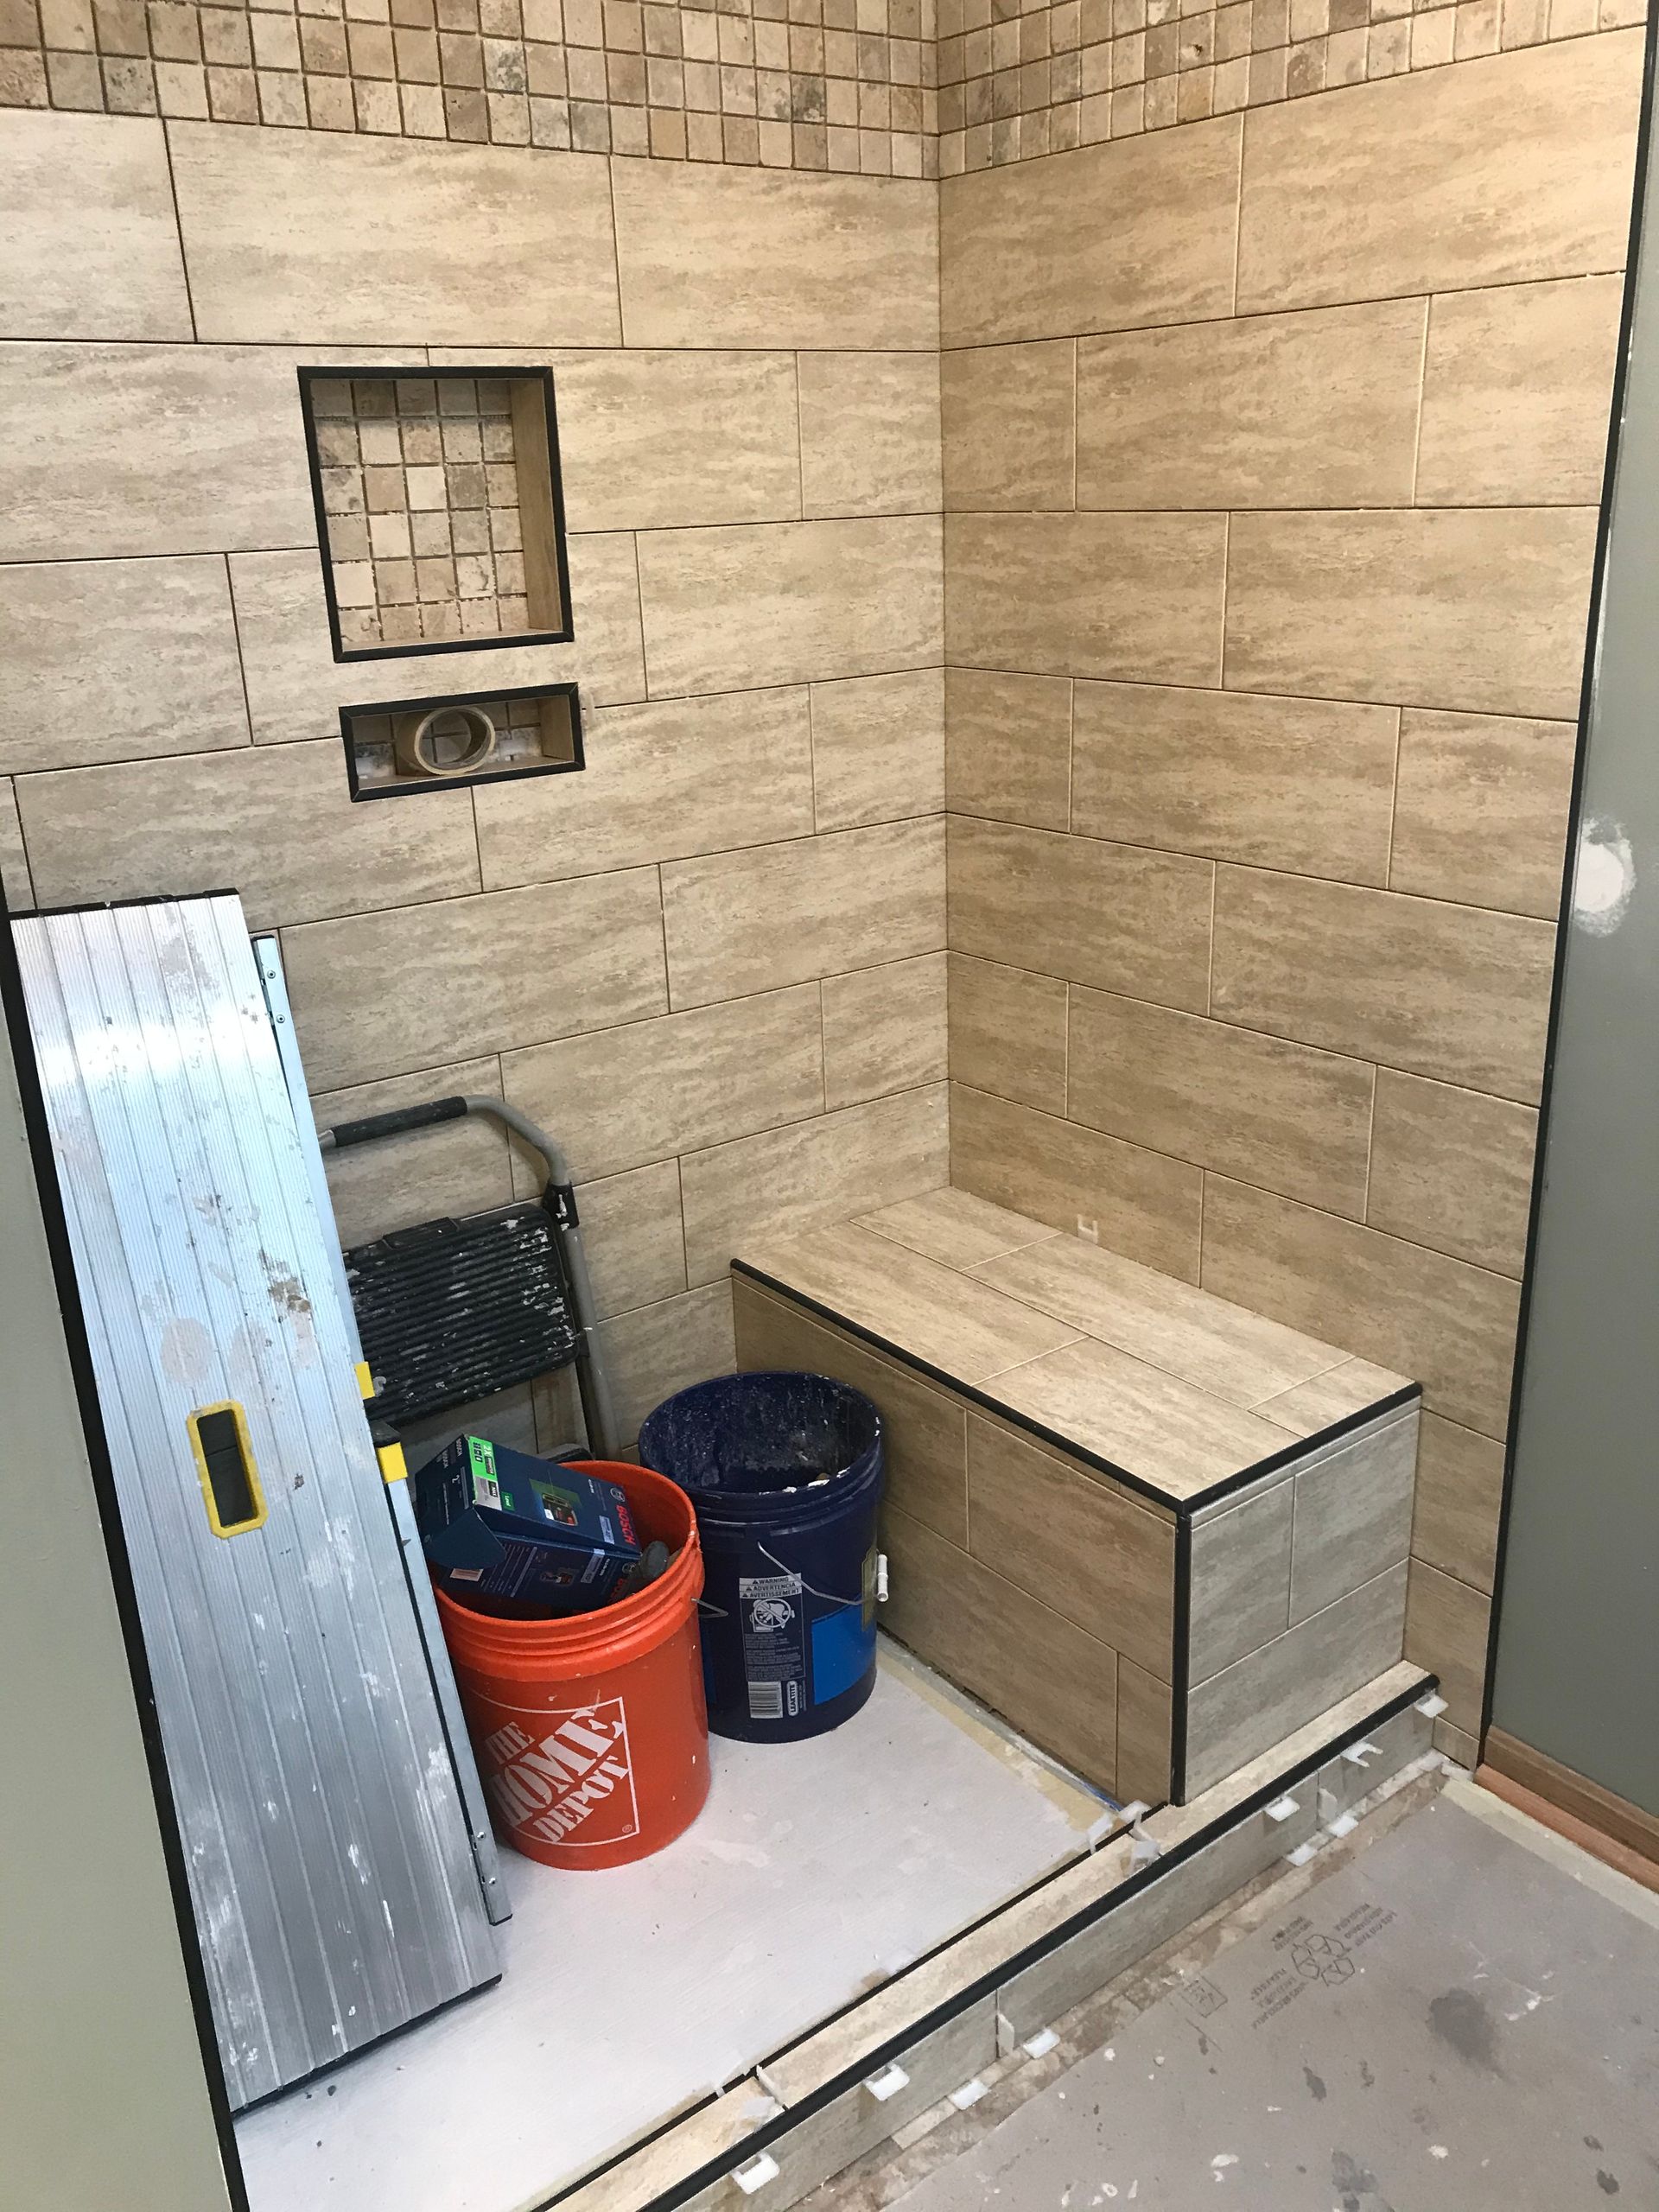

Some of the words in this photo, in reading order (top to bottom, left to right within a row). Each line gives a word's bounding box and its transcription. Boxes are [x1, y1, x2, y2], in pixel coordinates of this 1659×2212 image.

[615, 1504, 637, 1546] BOSCH
[749, 1588, 799, 1598] AVERTISSEMENT
[753, 1582, 796, 1591] ADVERTENCIA
[485, 1721, 536, 1765] THE
[488, 1707, 625, 1828] HOME
[532, 1754, 630, 1843] DEPOT
